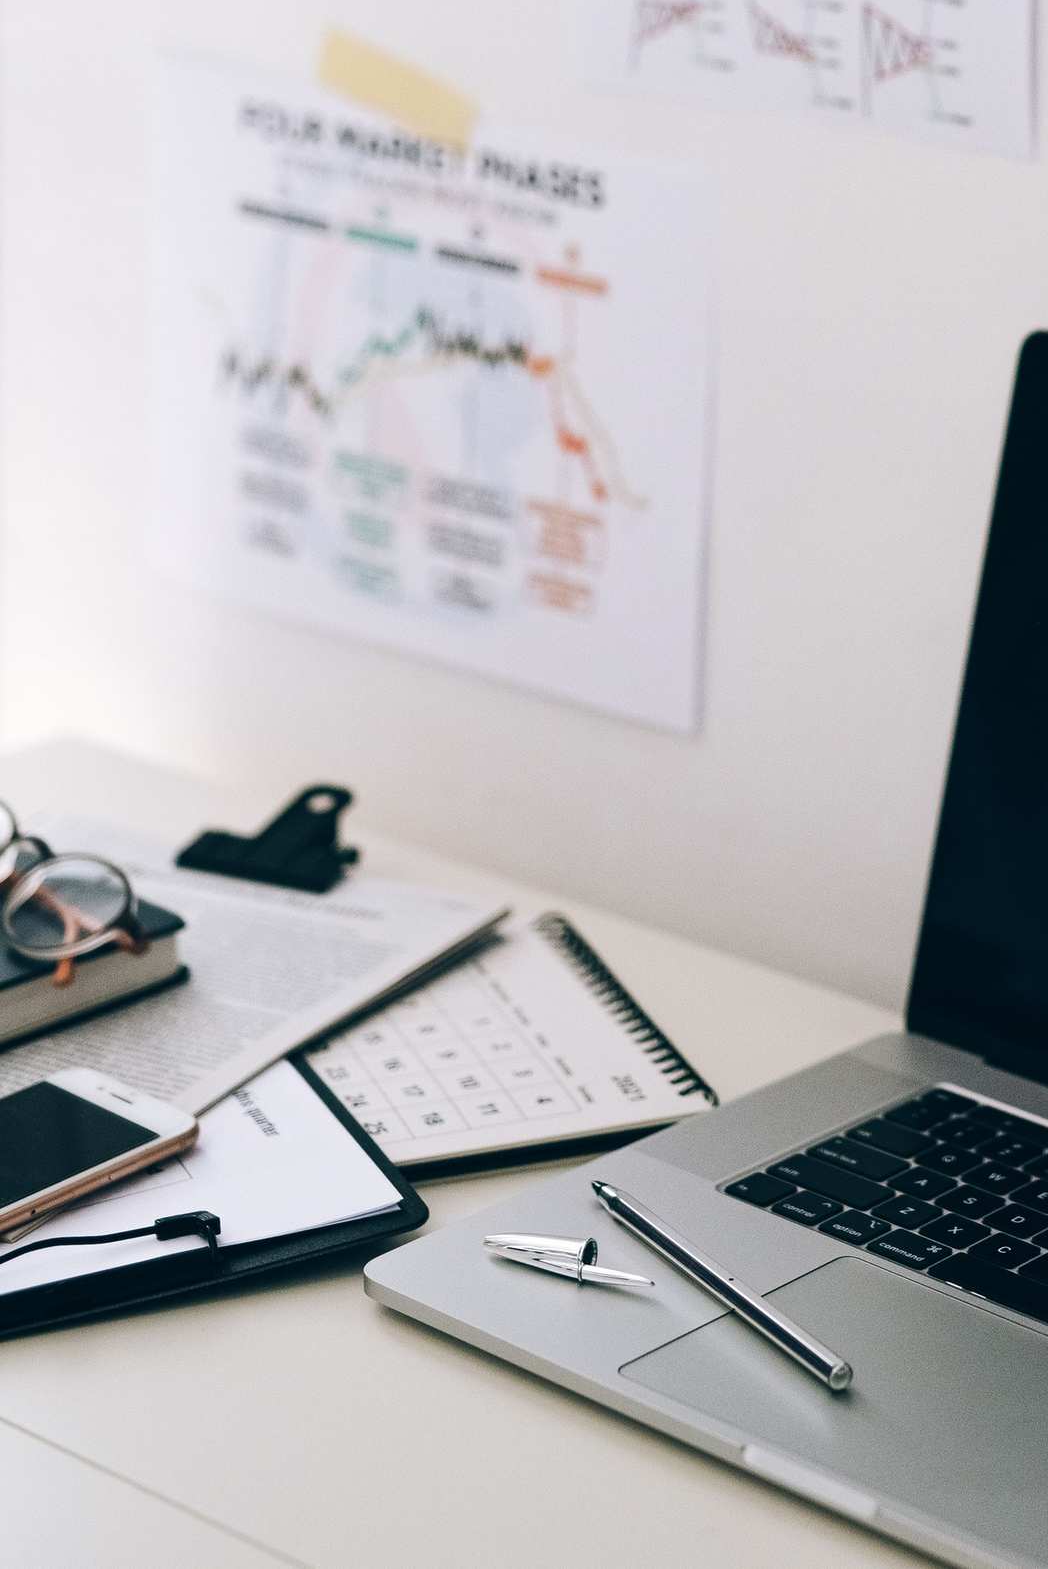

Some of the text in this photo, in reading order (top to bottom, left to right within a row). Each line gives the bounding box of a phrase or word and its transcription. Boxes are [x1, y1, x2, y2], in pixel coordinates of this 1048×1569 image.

[963, 1196, 977, 1205] S
[782, 1202, 816, 1218] control
[900, 1206, 915, 1215] Z
[1010, 1215, 1025, 1224] D
[833, 1222, 862, 1238] option
[947, 1226, 964, 1235] X
[879, 1242, 925, 1262] command
[997, 1245, 1012, 1254] C
